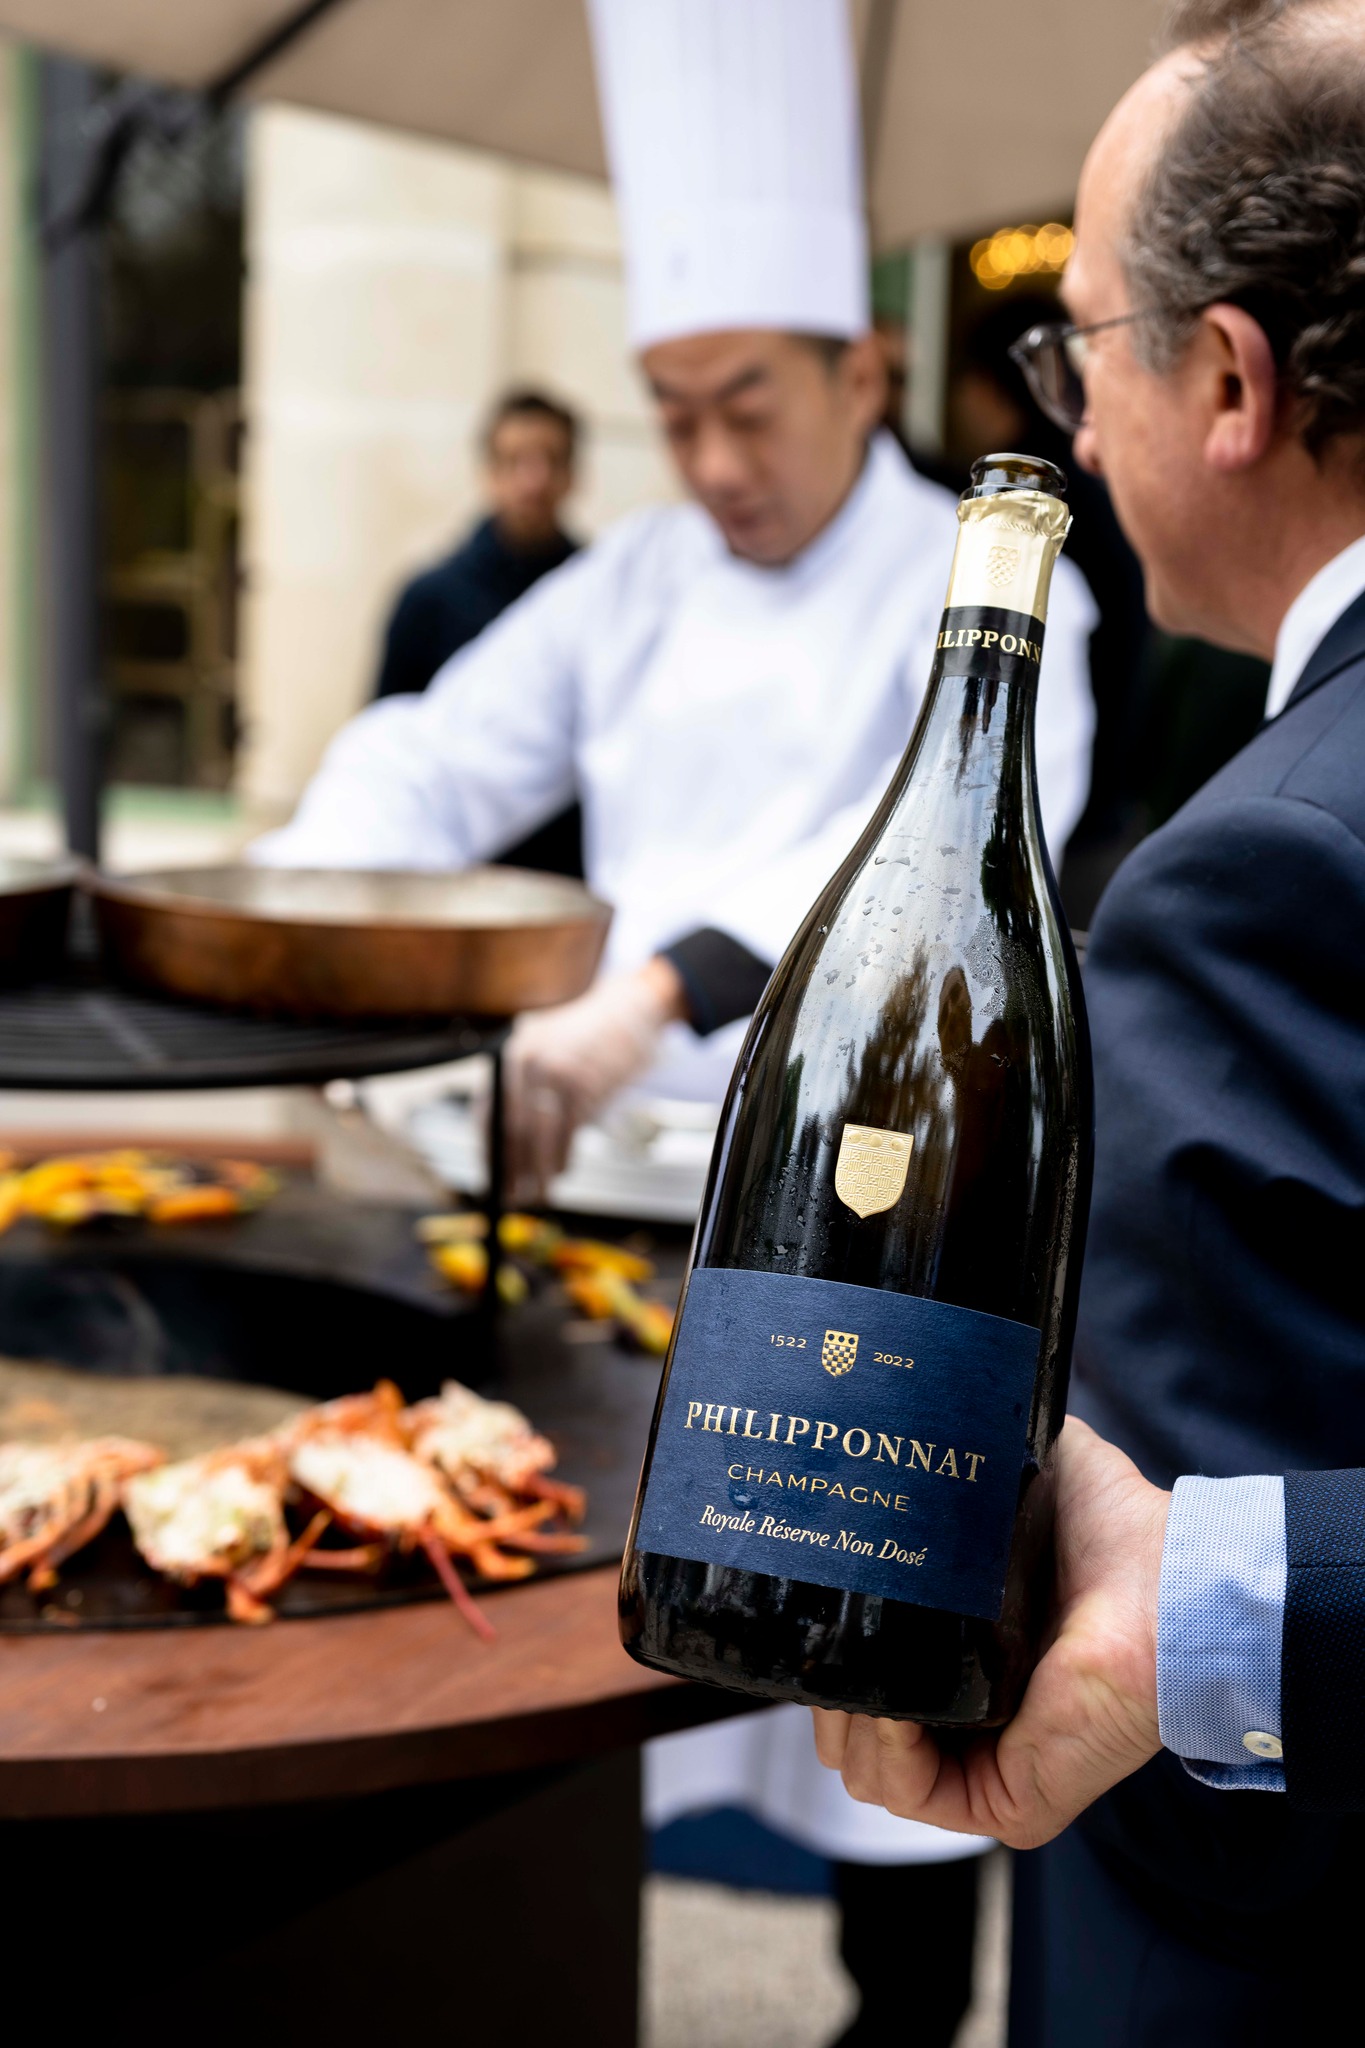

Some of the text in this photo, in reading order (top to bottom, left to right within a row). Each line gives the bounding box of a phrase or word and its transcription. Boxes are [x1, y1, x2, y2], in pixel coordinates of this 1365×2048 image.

[770, 1334, 915, 1369] 1522 2022
[684, 1401, 986, 1483] PHILIPPONNAT
[727, 1463, 911, 1512] CHAMPAGNE
[699, 1505, 928, 1567] Royale Réserve Non Dosé
